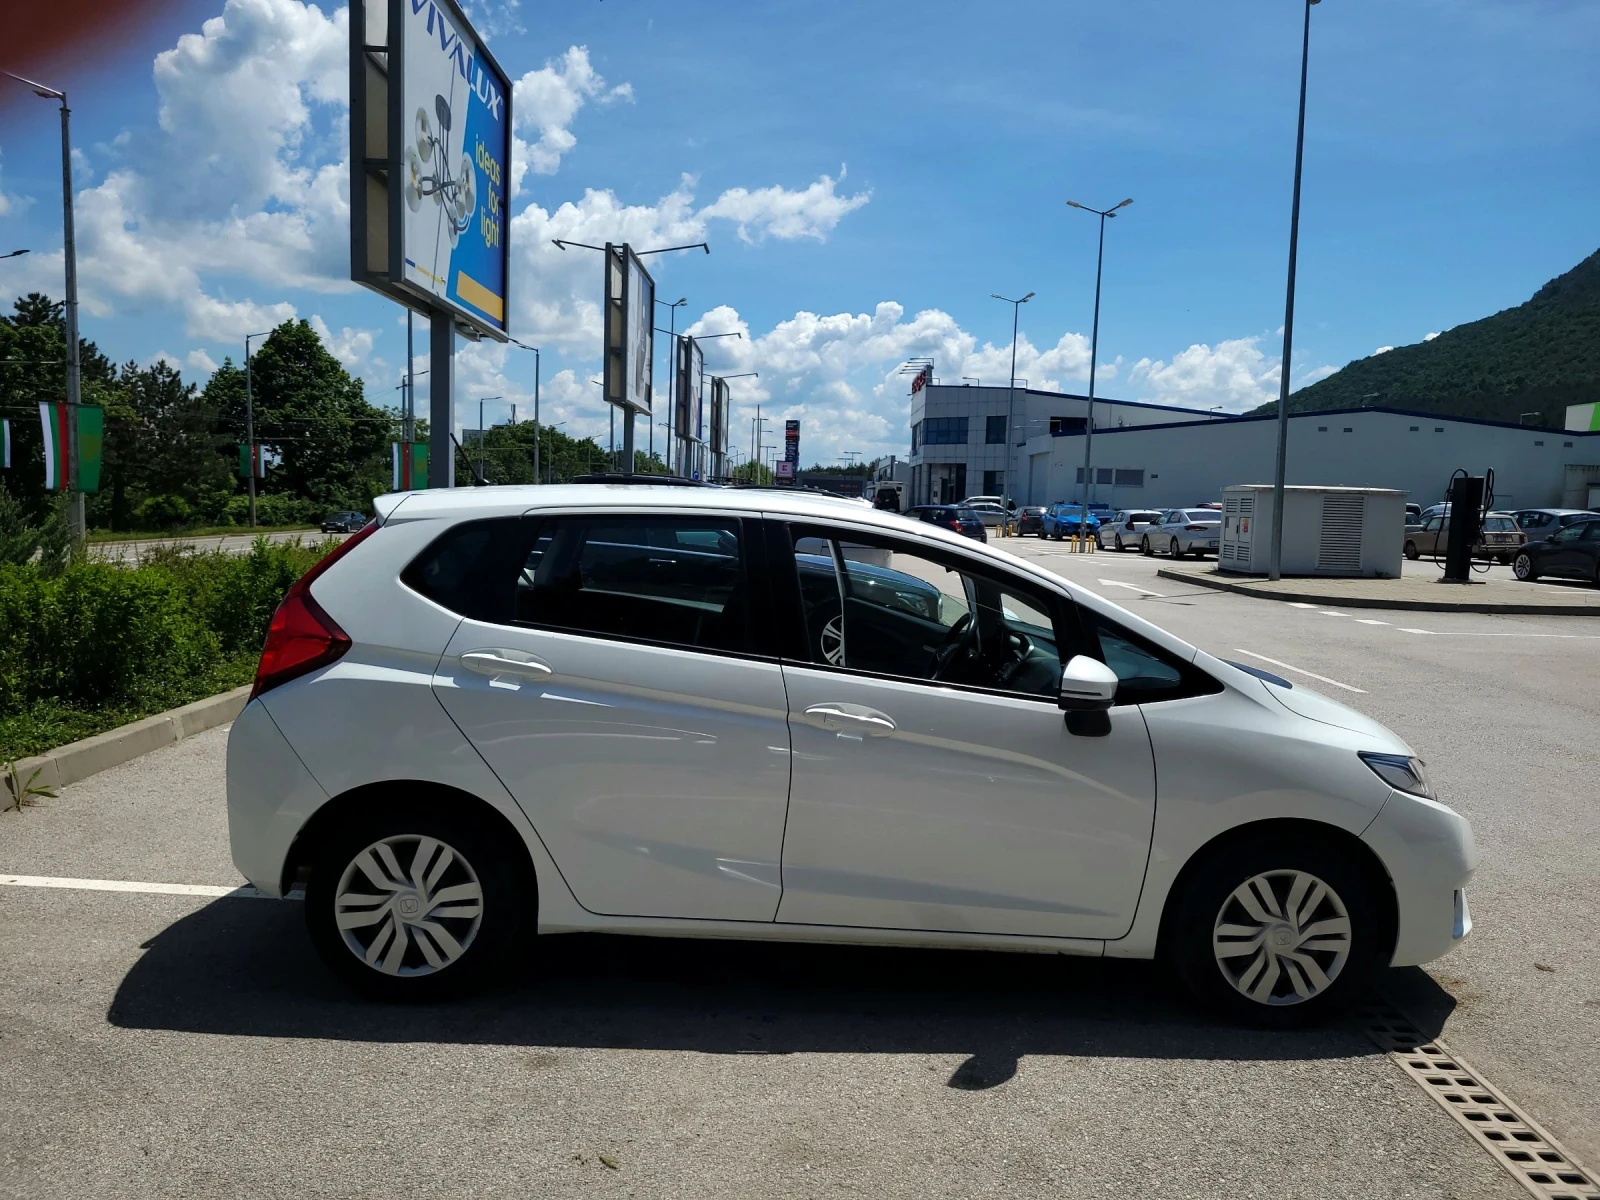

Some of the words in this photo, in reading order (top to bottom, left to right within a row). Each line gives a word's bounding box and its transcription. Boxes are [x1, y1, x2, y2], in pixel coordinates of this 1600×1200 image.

[475, 133, 500, 187] ideas
[488, 181, 499, 217] for
[481, 205, 499, 248] light
